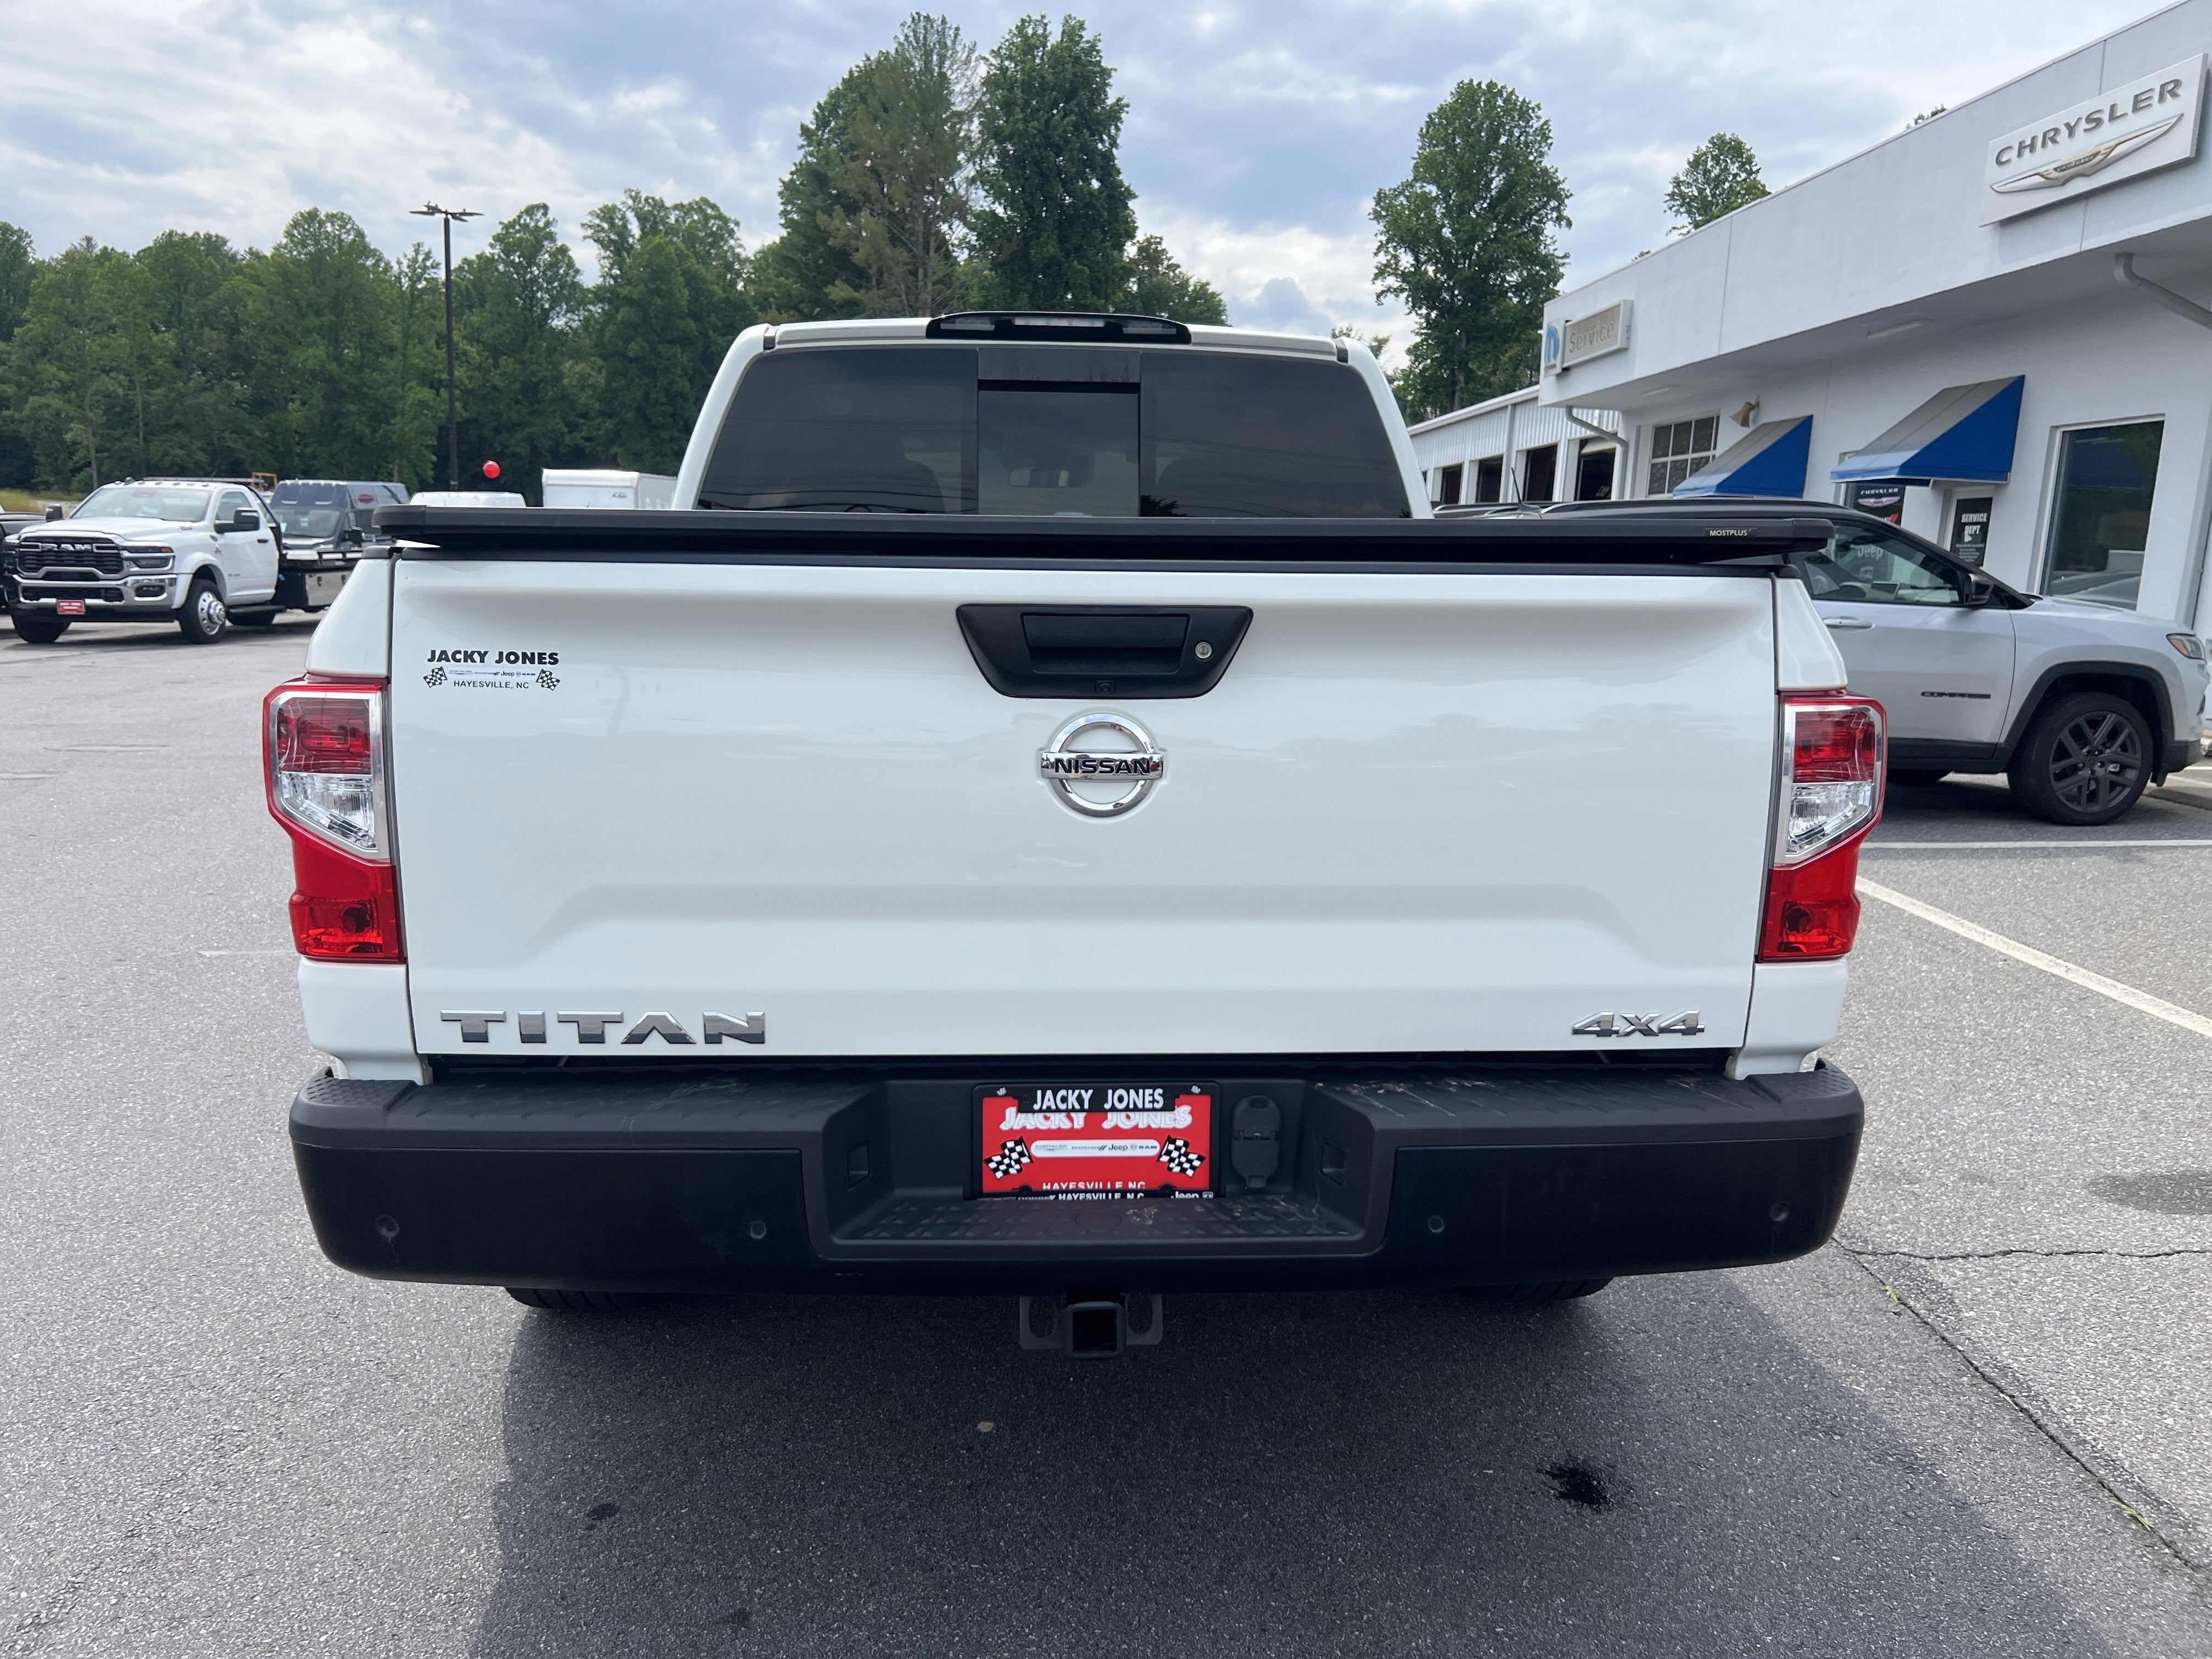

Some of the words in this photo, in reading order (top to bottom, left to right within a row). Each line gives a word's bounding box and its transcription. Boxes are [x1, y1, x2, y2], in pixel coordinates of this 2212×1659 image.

[1995, 78, 2182, 167] CHRYSLER
[1568, 320, 1614, 353] Service
[1961, 512, 1987, 523] SERVICE
[1965, 524, 1980, 535] DEPT
[42, 543, 92, 551] RAM
[1857, 546, 1883, 561] Jeep
[427, 650, 489, 663] JACKY
[494, 651, 560, 665] JONES
[454, 680, 514, 689] HAYESVILLE,
[1054, 758, 1150, 775] NISSAN
[440, 1009, 765, 1045] TITAN
[1033, 1088, 1093, 1110] JACKY
[1103, 1088, 1164, 1110] JONES
[1000, 1107, 1088, 1130] JACKY
[1102, 1104, 1193, 1130] JONES
